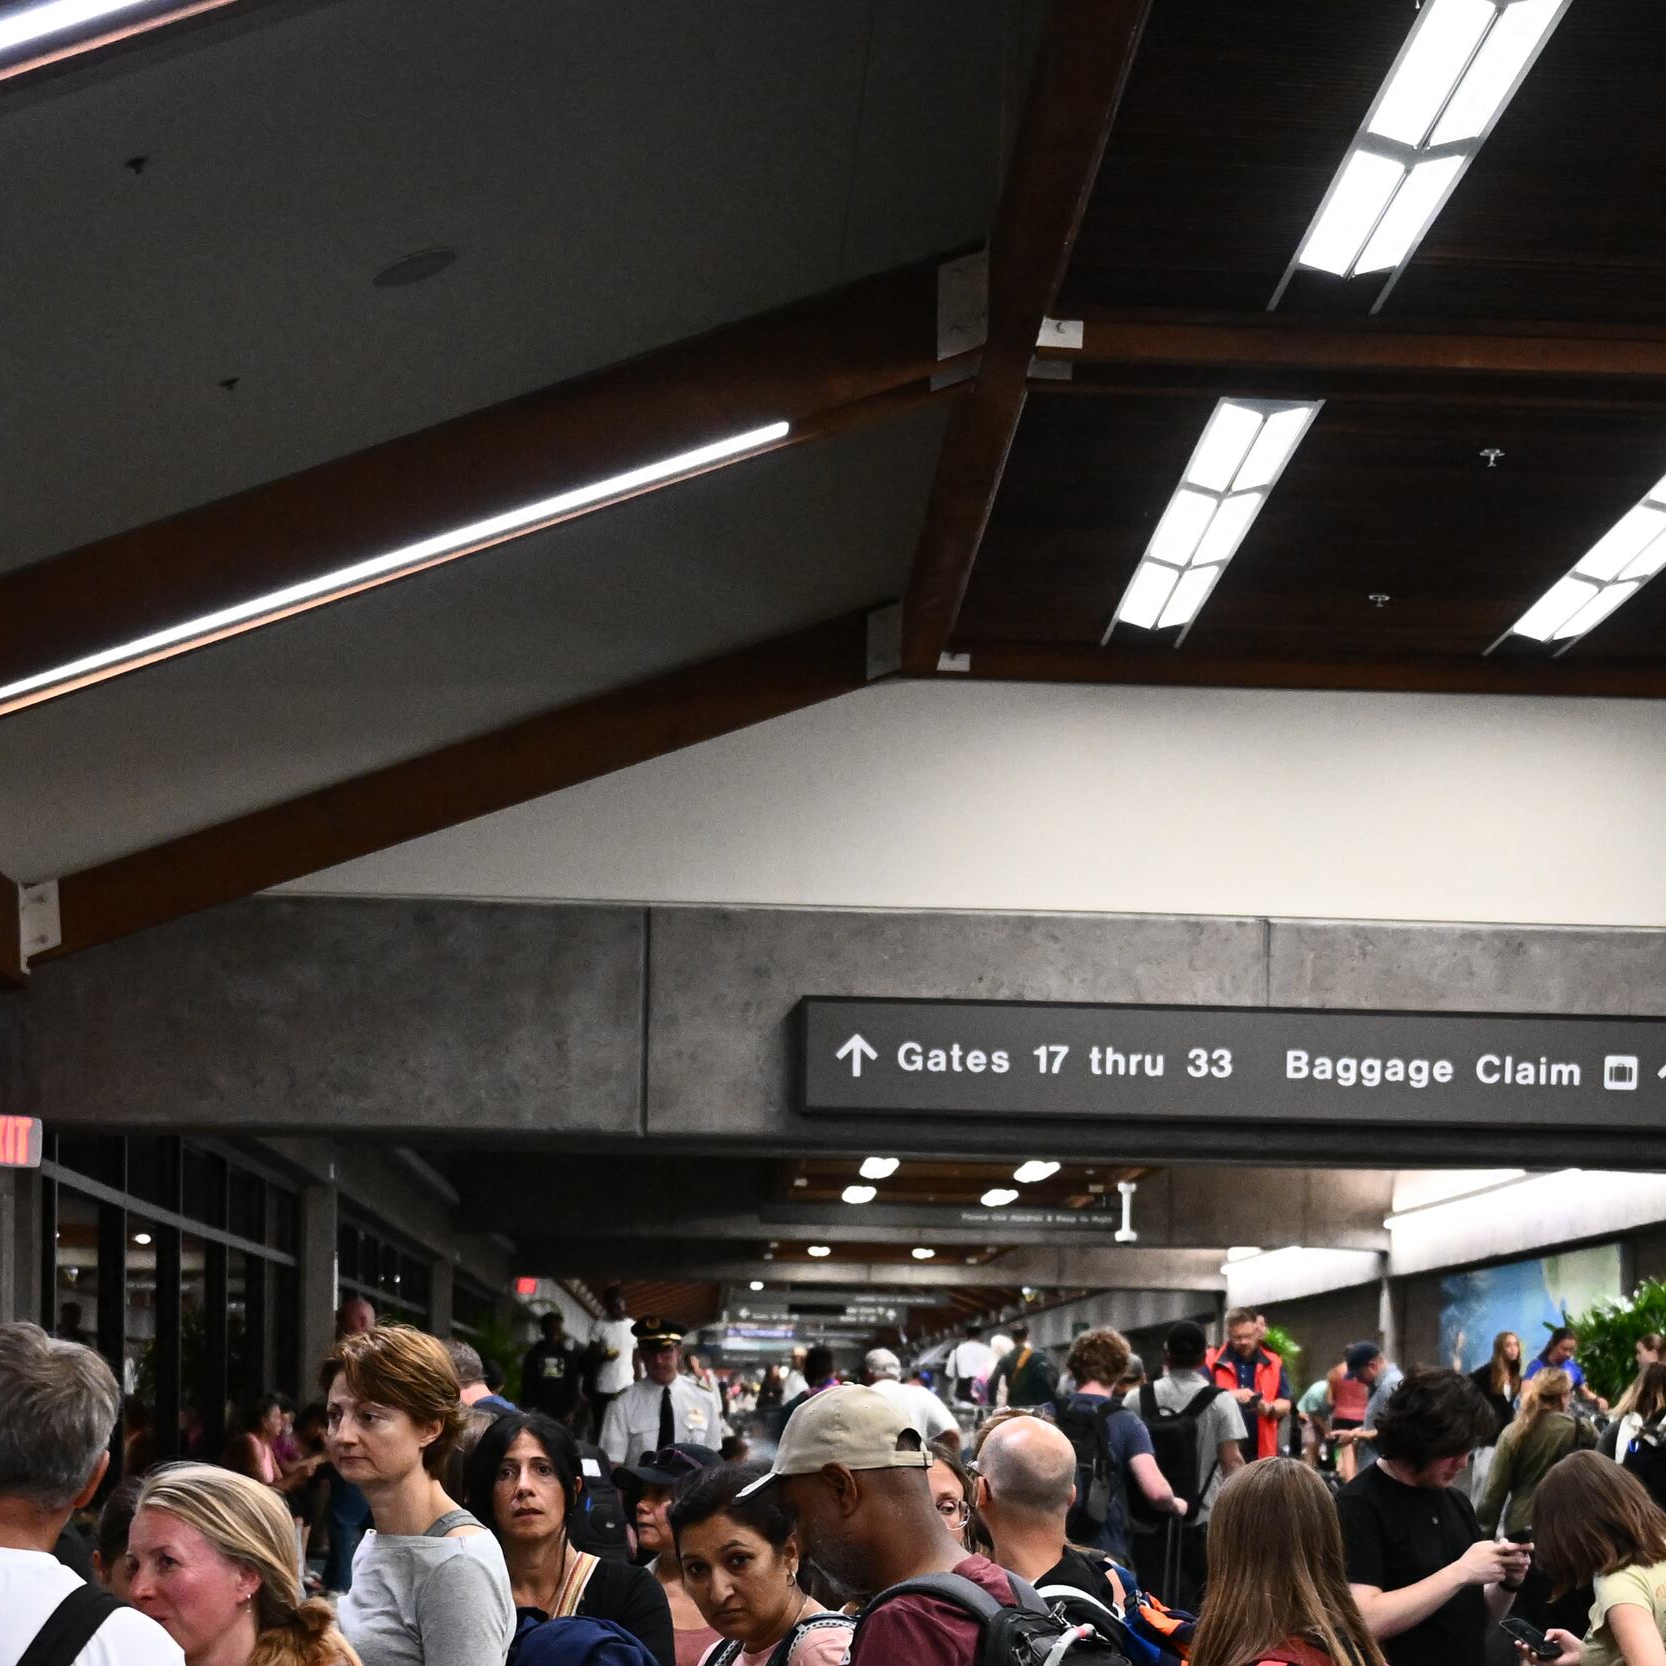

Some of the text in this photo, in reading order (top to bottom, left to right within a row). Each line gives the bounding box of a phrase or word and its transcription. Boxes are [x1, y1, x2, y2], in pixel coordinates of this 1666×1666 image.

[897, 1042, 1232, 1079] Gates 17 thru 33
[1286, 1050, 1581, 1089] Baggage Claim
